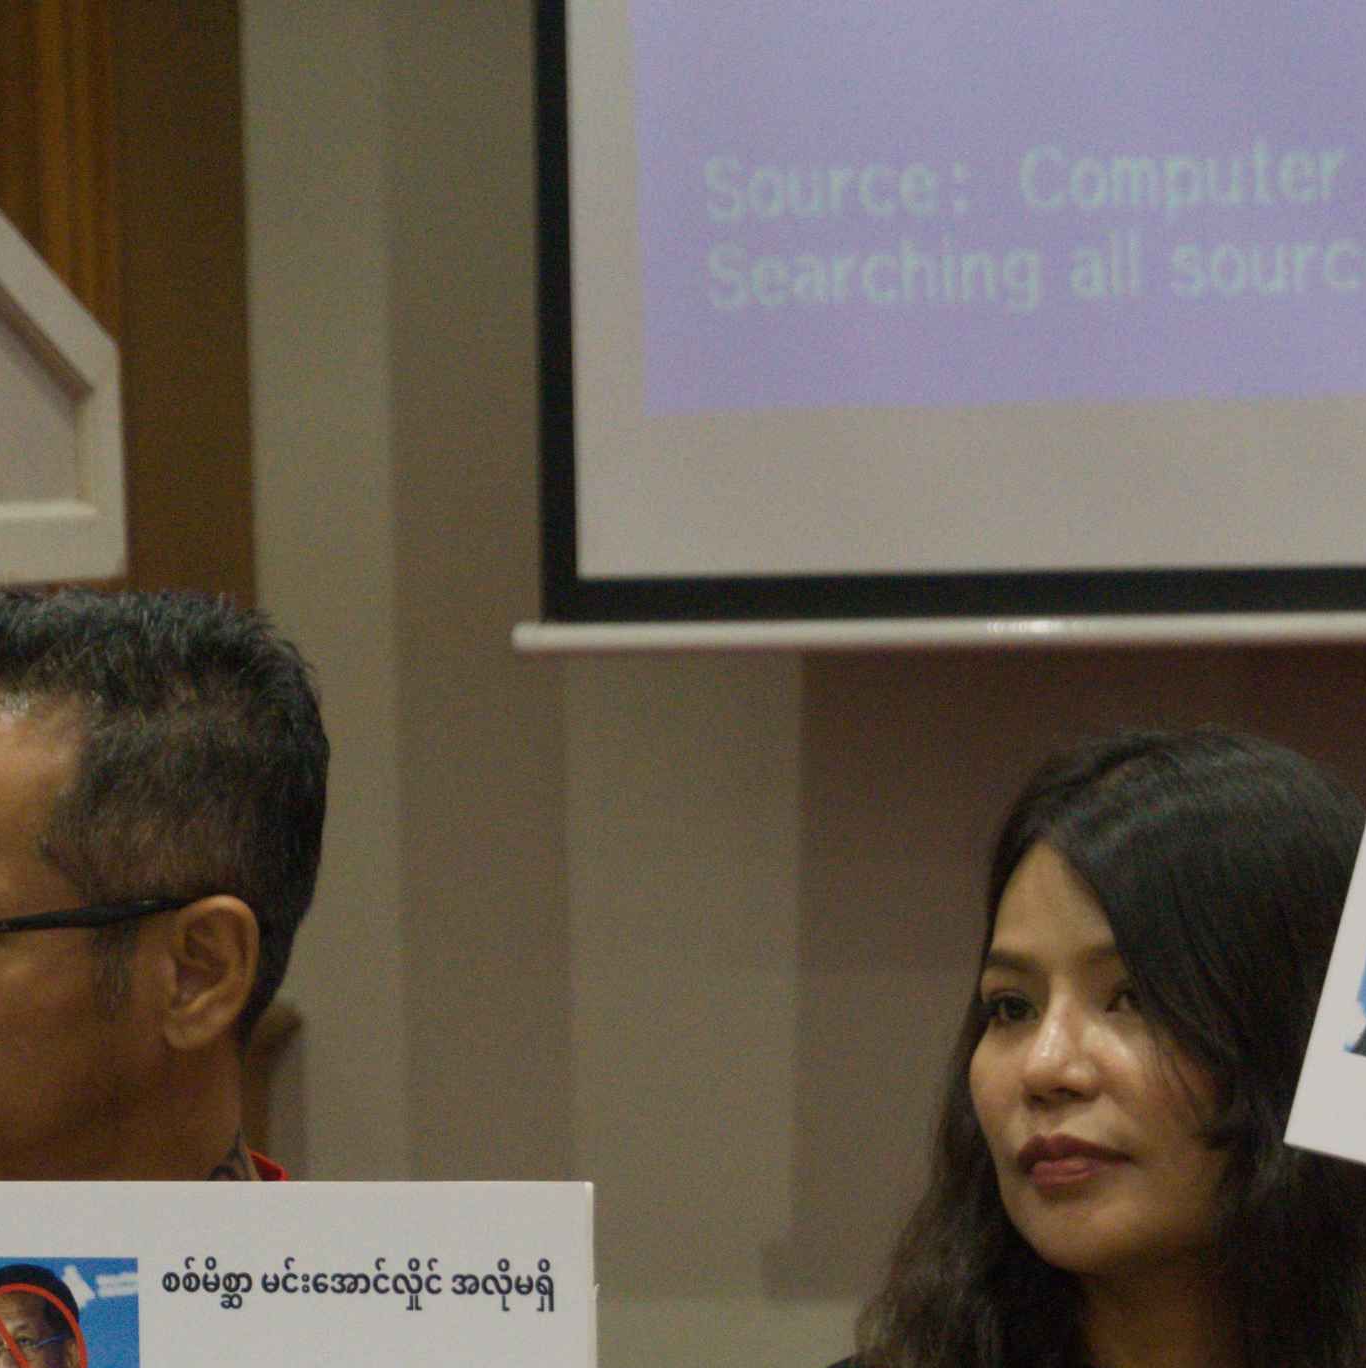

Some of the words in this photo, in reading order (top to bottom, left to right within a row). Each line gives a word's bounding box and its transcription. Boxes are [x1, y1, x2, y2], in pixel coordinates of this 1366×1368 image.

[703, 152, 970, 224] Source:
[1017, 138, 1346, 222] Computer
[707, 234, 1044, 312] Searching
[1069, 230, 1143, 299] all
